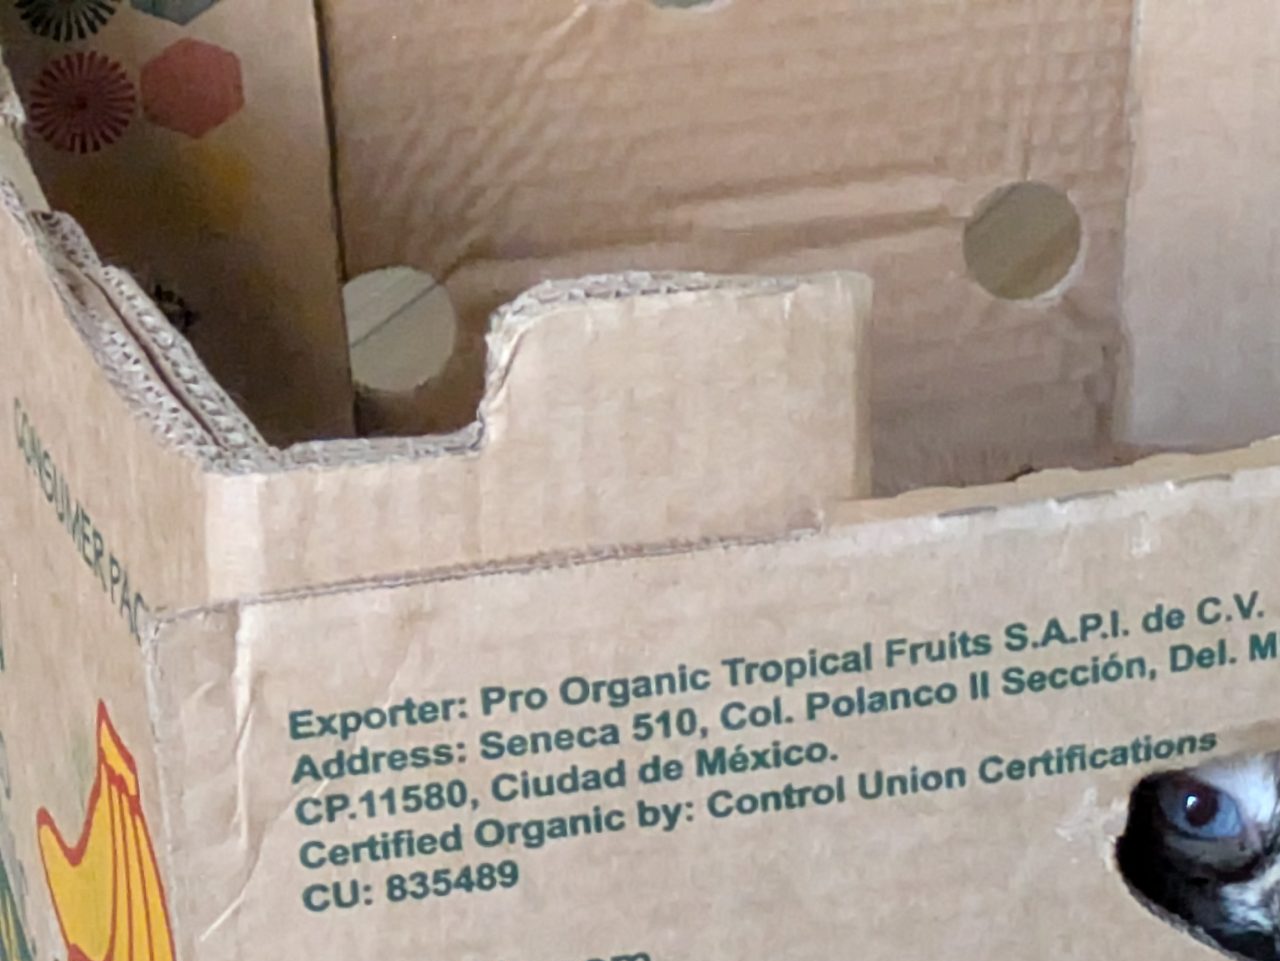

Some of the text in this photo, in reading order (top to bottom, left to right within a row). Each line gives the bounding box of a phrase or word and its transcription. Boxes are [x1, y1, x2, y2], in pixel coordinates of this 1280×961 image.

[108, 551, 158, 648] PAC
[288, 590, 1265, 741] Exporter: Pro Organic Tropical Fruits S.A.P.I. de C.V.
[290, 741, 467, 785] Address:
[479, 724, 621, 761] Seneca
[632, 706, 709, 742] 510,
[719, 695, 795, 732] Col.
[805, 682, 959, 721] Polanco
[969, 670, 991, 701] II
[1001, 652, 1158, 696] Sección,
[1168, 638, 1238, 673] Del.
[294, 739, 839, 827] CP.11580, Ciudad de México.
[298, 729, 1218, 871] Certified Organic by: Control Union Certifications
[300, 859, 521, 913] CU: 835489
